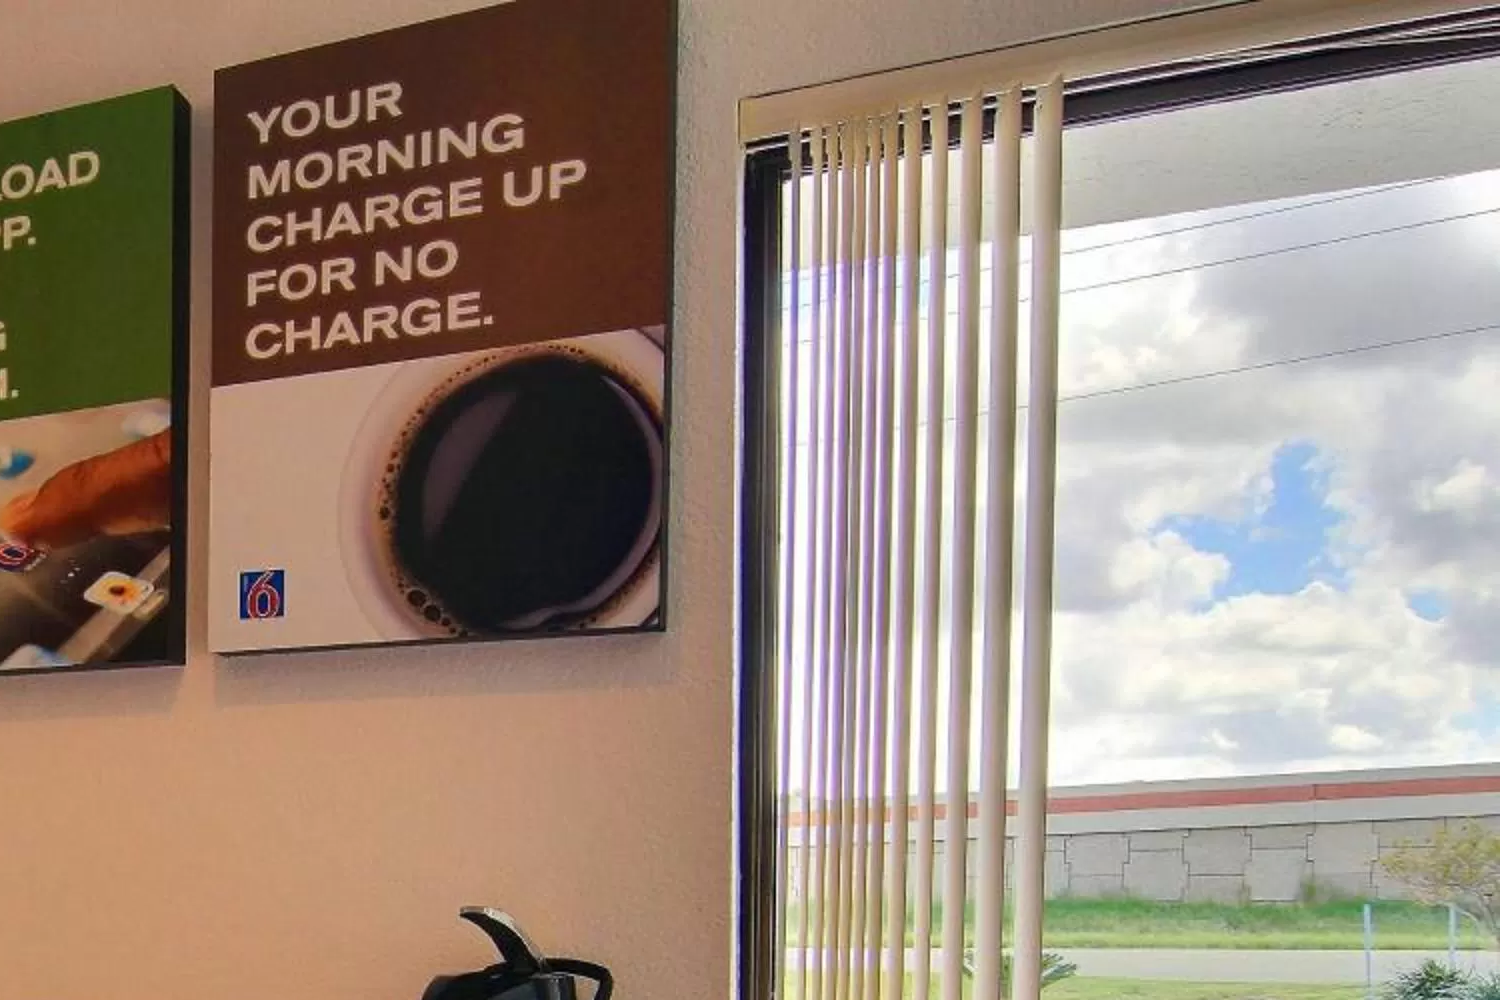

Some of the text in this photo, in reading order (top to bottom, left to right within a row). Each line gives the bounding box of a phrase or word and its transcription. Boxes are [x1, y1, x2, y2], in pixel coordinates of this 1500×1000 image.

[246, 81, 403, 144] YOUR
[247, 113, 525, 199] MORNING
[246, 159, 587, 253] CHARGE UP
[246, 240, 459, 307] FOR NO
[245, 291, 493, 360] CHARGE.
[247, 570, 280, 619] 6
